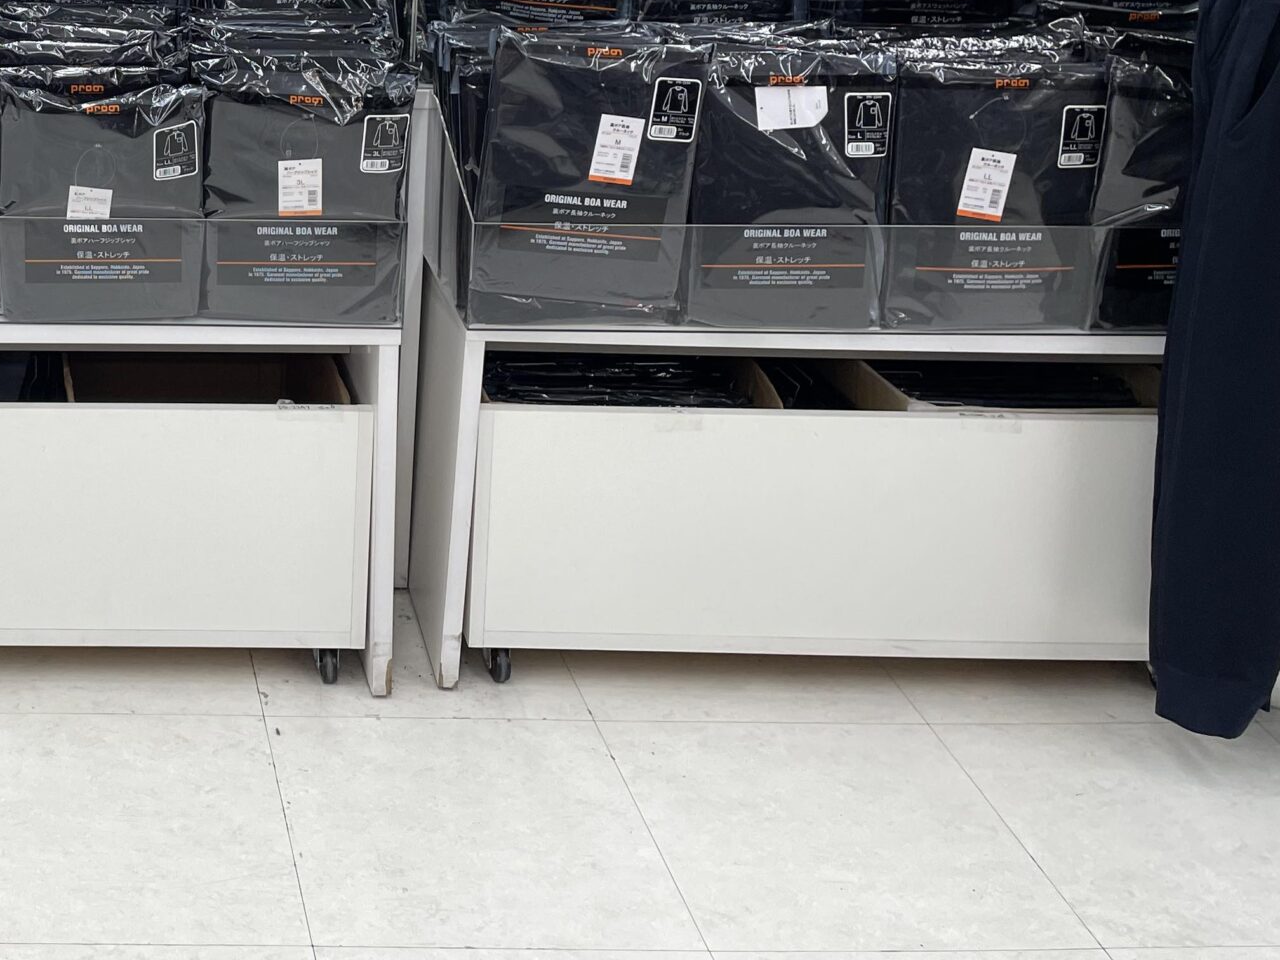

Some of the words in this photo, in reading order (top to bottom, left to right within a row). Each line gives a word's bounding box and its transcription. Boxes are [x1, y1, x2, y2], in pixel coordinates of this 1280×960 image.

[544, 193, 582, 205] ORIGINAL
[584, 197, 601, 207] BOA
[603, 199, 628, 209] WEAR
[63, 224, 100, 233] ORIGINAL
[101, 224, 118, 233] BOA
[120, 224, 143, 233] WEAR
[256, 226, 294, 235] ORIGINAL
[295, 227, 313, 235] BOA
[314, 227, 338, 236] WEAR
[743, 229, 782, 238] ORIGINAL
[783, 229, 801, 238] BOA
[803, 228, 828, 238] WEAR
[959, 231, 998, 241] ORIGINAL
[999, 232, 1017, 241] BOA
[1018, 232, 1042, 241] WEAR
